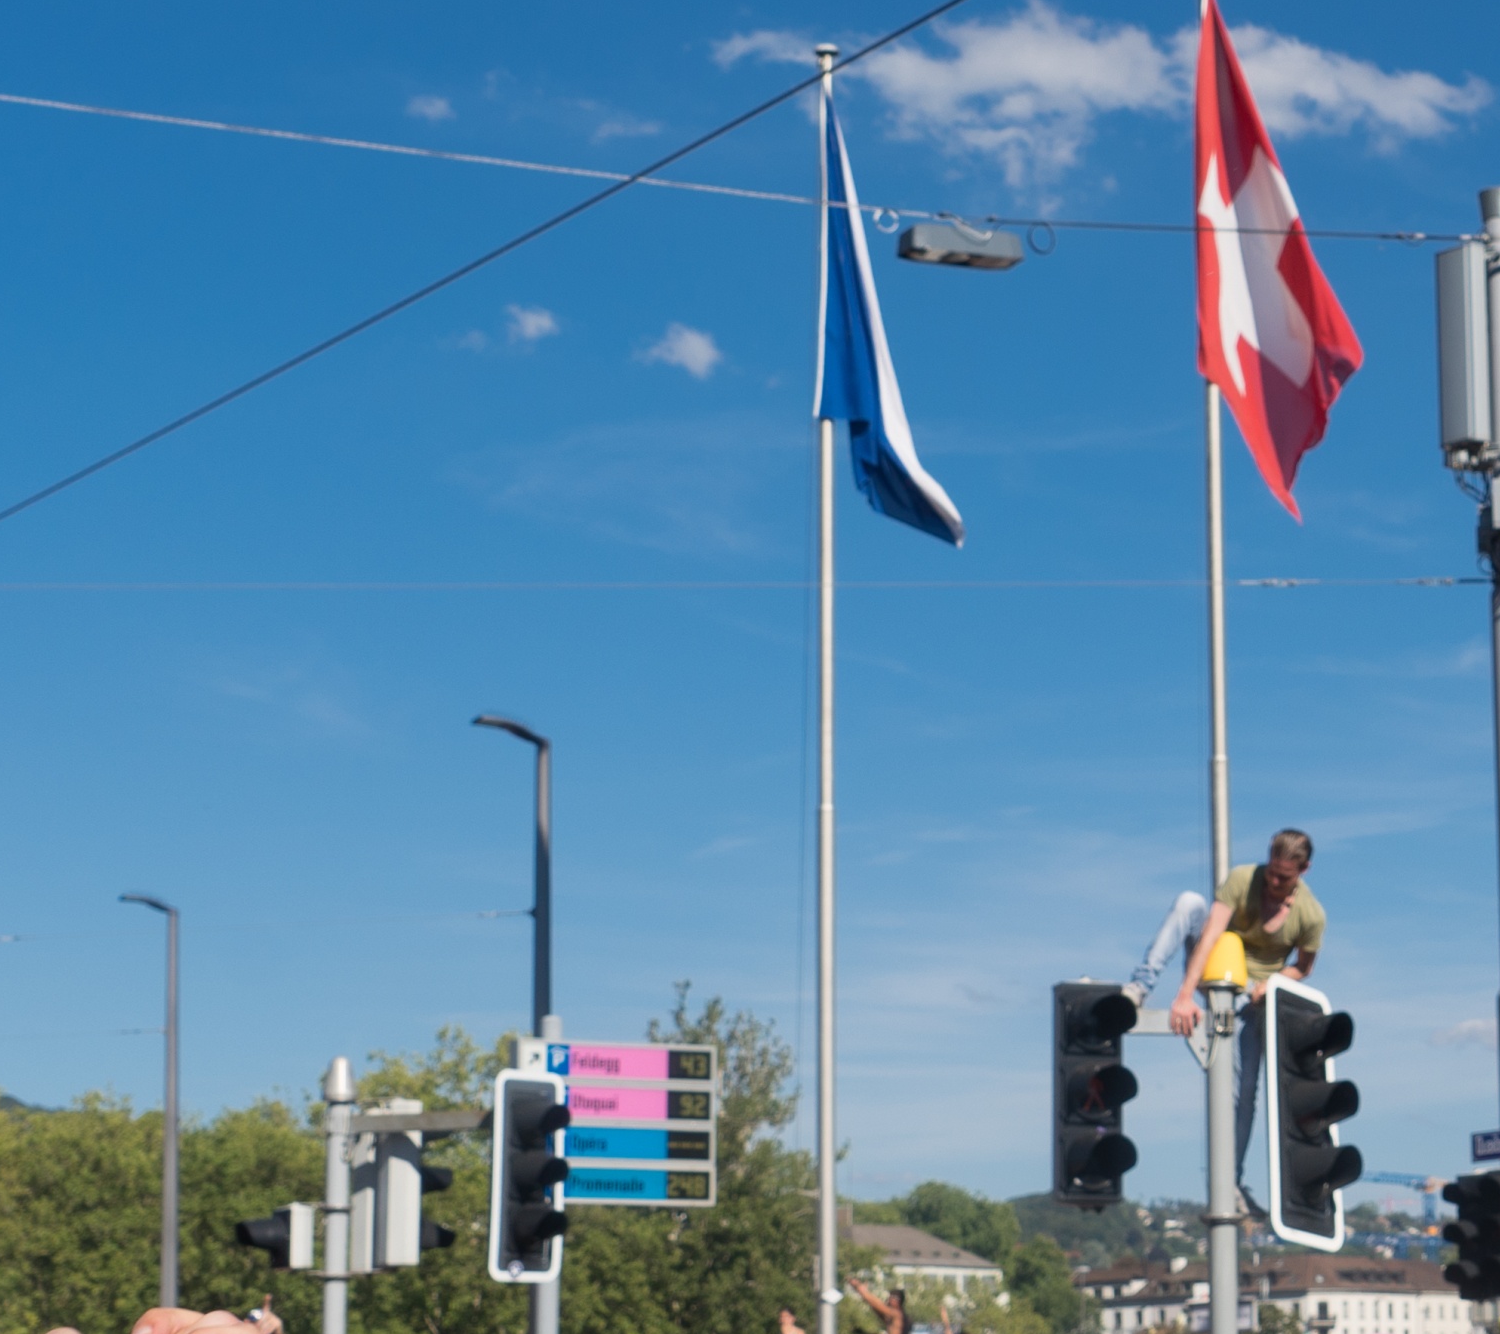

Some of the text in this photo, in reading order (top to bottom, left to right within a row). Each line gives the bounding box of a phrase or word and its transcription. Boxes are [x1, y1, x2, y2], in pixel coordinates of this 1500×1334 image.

[572, 1053, 620, 1073] Feldegg
[678, 1054, 708, 1077] 43
[678, 1094, 708, 1116] 92
[571, 1175, 707, 1198] Promenade 248
